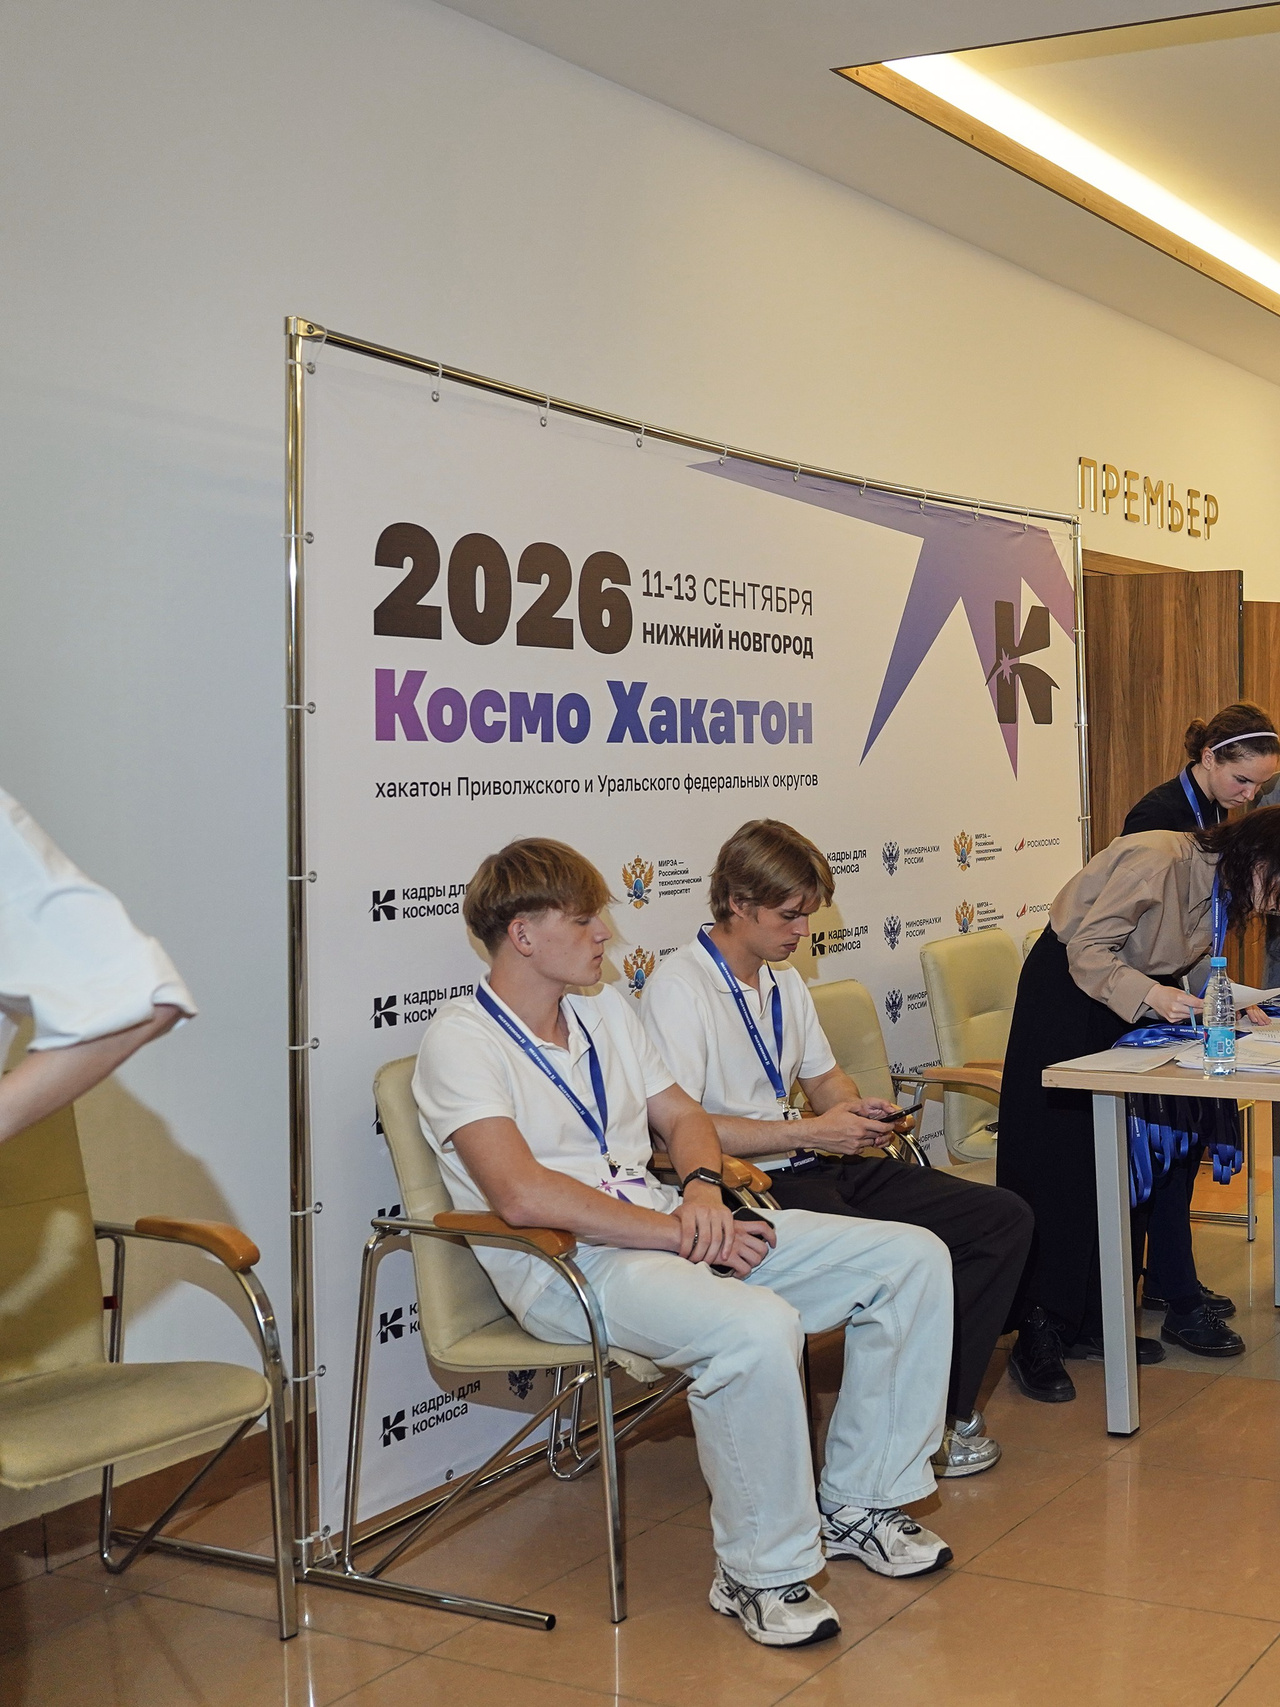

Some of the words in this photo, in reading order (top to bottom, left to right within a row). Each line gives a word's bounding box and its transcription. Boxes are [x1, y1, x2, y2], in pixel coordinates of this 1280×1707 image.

[1077, 456, 1219, 541] ПРЕМЬЕР
[374, 522, 632, 655] 2026
[643, 569, 696, 601] 11-13
[704, 578, 813, 616] СЕНТЯБРЯ
[642, 622, 724, 650] НИЖНИЙ
[729, 629, 814, 660] НОВГОРОД
[375, 668, 591, 744] Космо
[606, 680, 813, 745] Хакатон
[375, 781, 451, 799] хакатон
[457, 776, 581, 802] Приволжского
[584, 779, 593, 793] и
[597, 774, 681, 797] Уральского
[684, 771, 769, 795] федеральных
[772, 773, 819, 791] округов
[904, 845, 940, 855] МИНОБРНАУКИ
[1027, 838, 1060, 848] РОСКОСМОС
[658, 859, 678, 867] МИРЭА
[827, 851, 852, 863] кадры
[853, 849, 867, 861] для
[904, 857, 924, 865] РОССИИ
[658, 868, 689, 877] Российский
[658, 876, 702, 887] технологический
[402, 884, 446, 904] кадры
[448, 883, 468, 898] дл
[658, 887, 691, 898] университет
[402, 902, 460, 919] космоса
[906, 916, 942, 928] МИНОБРНАУКИ
[828, 927, 854, 940] кадры
[854, 925, 868, 937] для
[906, 929, 926, 938] РОССИИ
[828, 940, 861, 954] космоса
[403, 988, 447, 1009] кадры
[449, 984, 474, 1001] для
[411, 1390, 456, 1419] кадры
[456, 1380, 481, 1402] для
[411, 1402, 469, 1436] космоса
